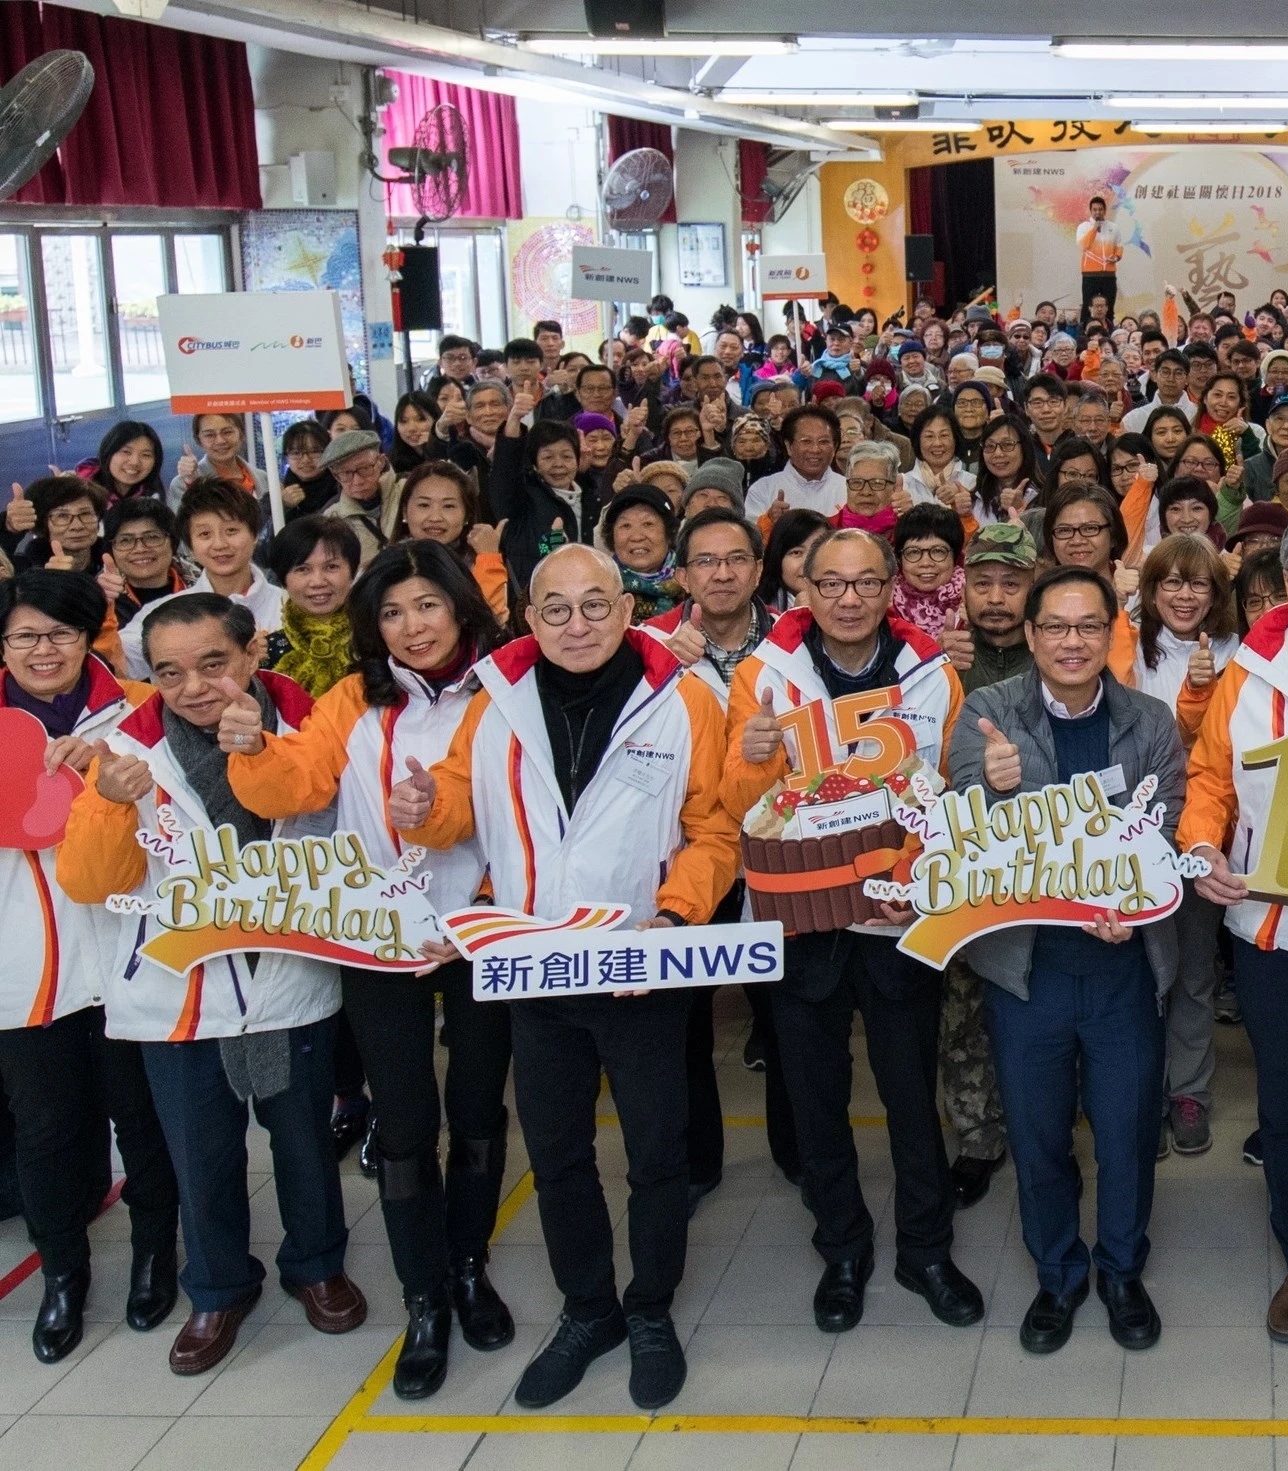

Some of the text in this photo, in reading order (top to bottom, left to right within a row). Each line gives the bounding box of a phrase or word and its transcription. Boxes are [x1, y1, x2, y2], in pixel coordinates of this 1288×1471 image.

[1135, 184, 1282, 200] 創建社區關懷日2018
[584, 274, 639, 284] 新創建 NWS
[186, 340, 223, 350] CITYBUS
[655, 752, 675, 761] NWS
[777, 685, 917, 791] 15
[816, 810, 880, 831] 新創建 NWS
[942, 774, 1124, 858] Happy
[189, 826, 387, 893] Happy
[914, 838, 1157, 916] Birthday
[156, 876, 417, 963] Birthday
[481, 941, 778, 994] 新創建 NWS
